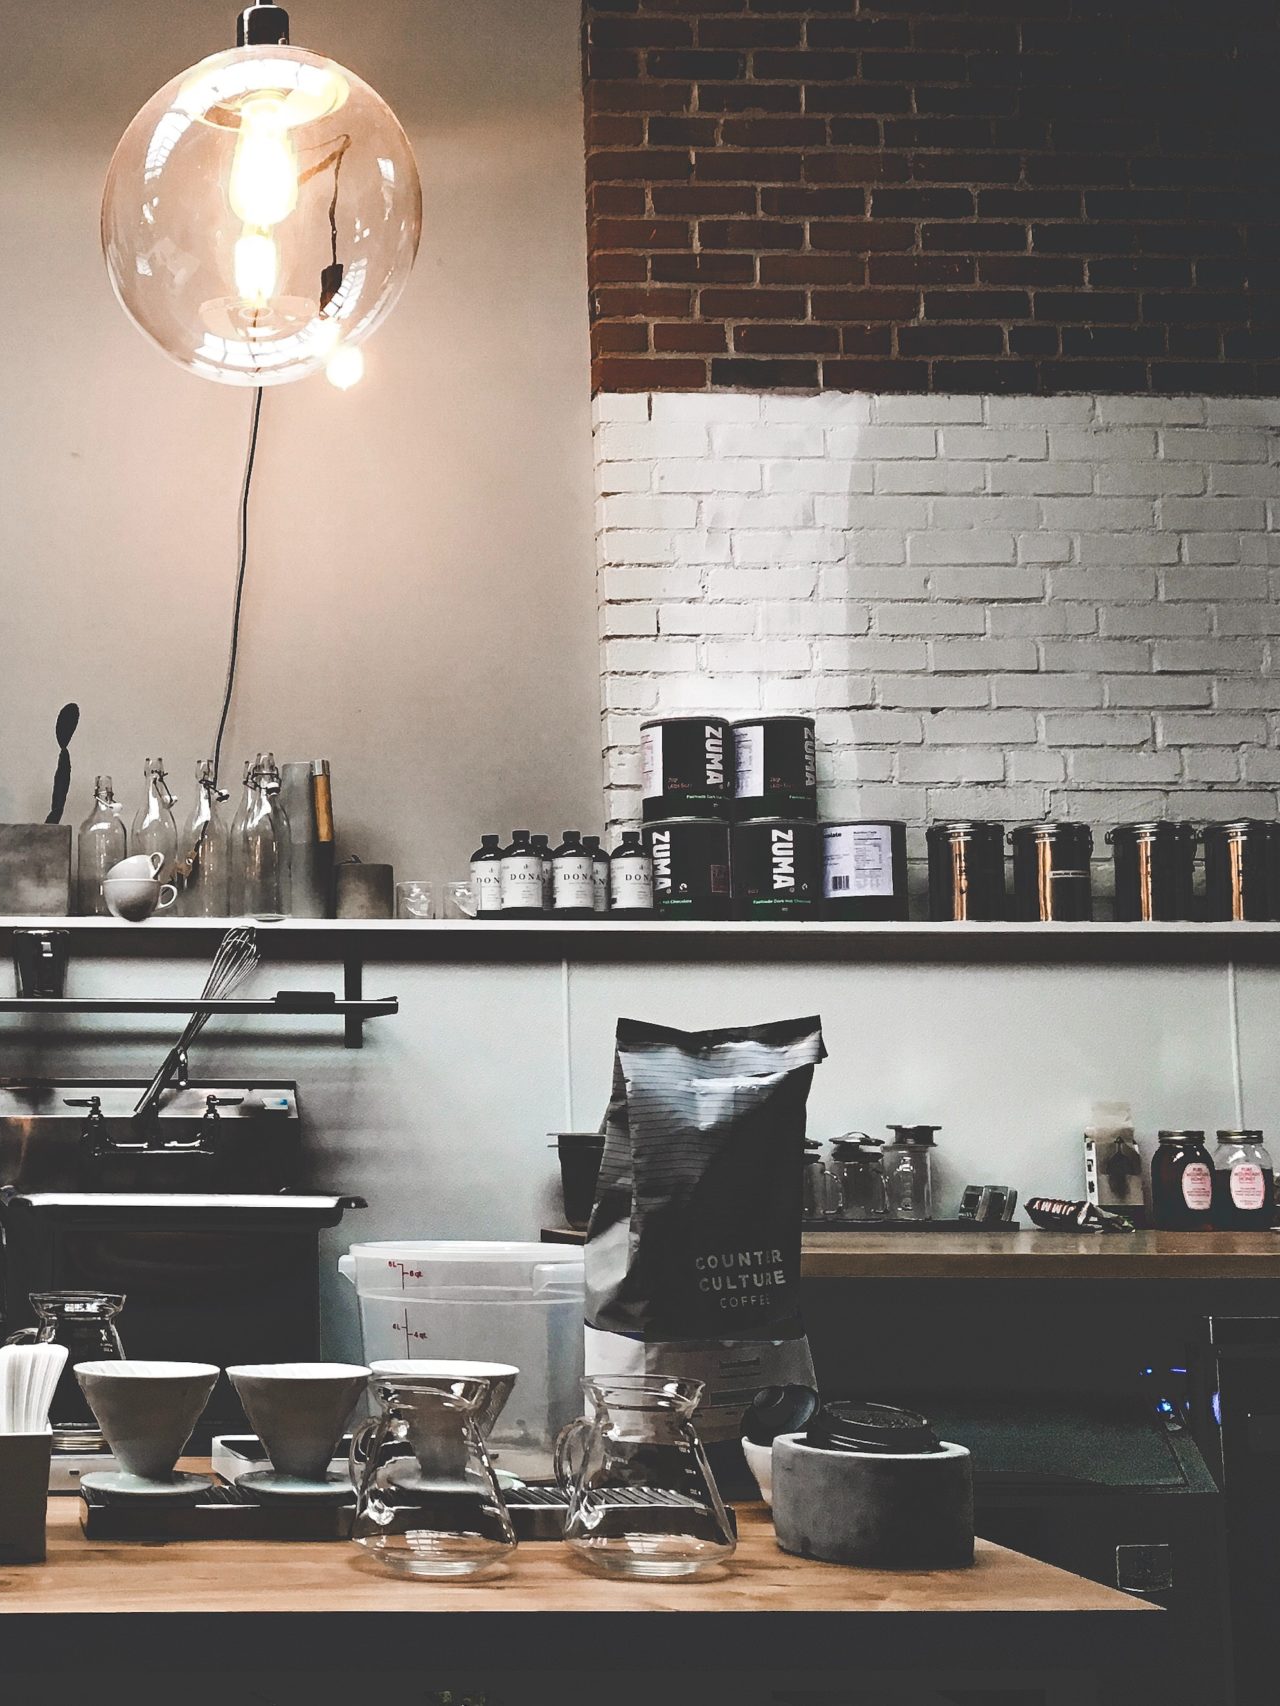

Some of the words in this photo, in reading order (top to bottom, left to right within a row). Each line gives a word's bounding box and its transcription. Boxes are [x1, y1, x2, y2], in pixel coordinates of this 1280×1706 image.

[704, 725, 724, 786] ZUMA
[803, 727, 816, 787] ZUMA
[476, 876, 500, 884] DON
[652, 830, 672, 891] ZUMA
[771, 829, 795, 890] ZUMA
[1032, 1199, 1077, 1216] JIMMY
[698, 1270, 787, 1292] CULTURE
